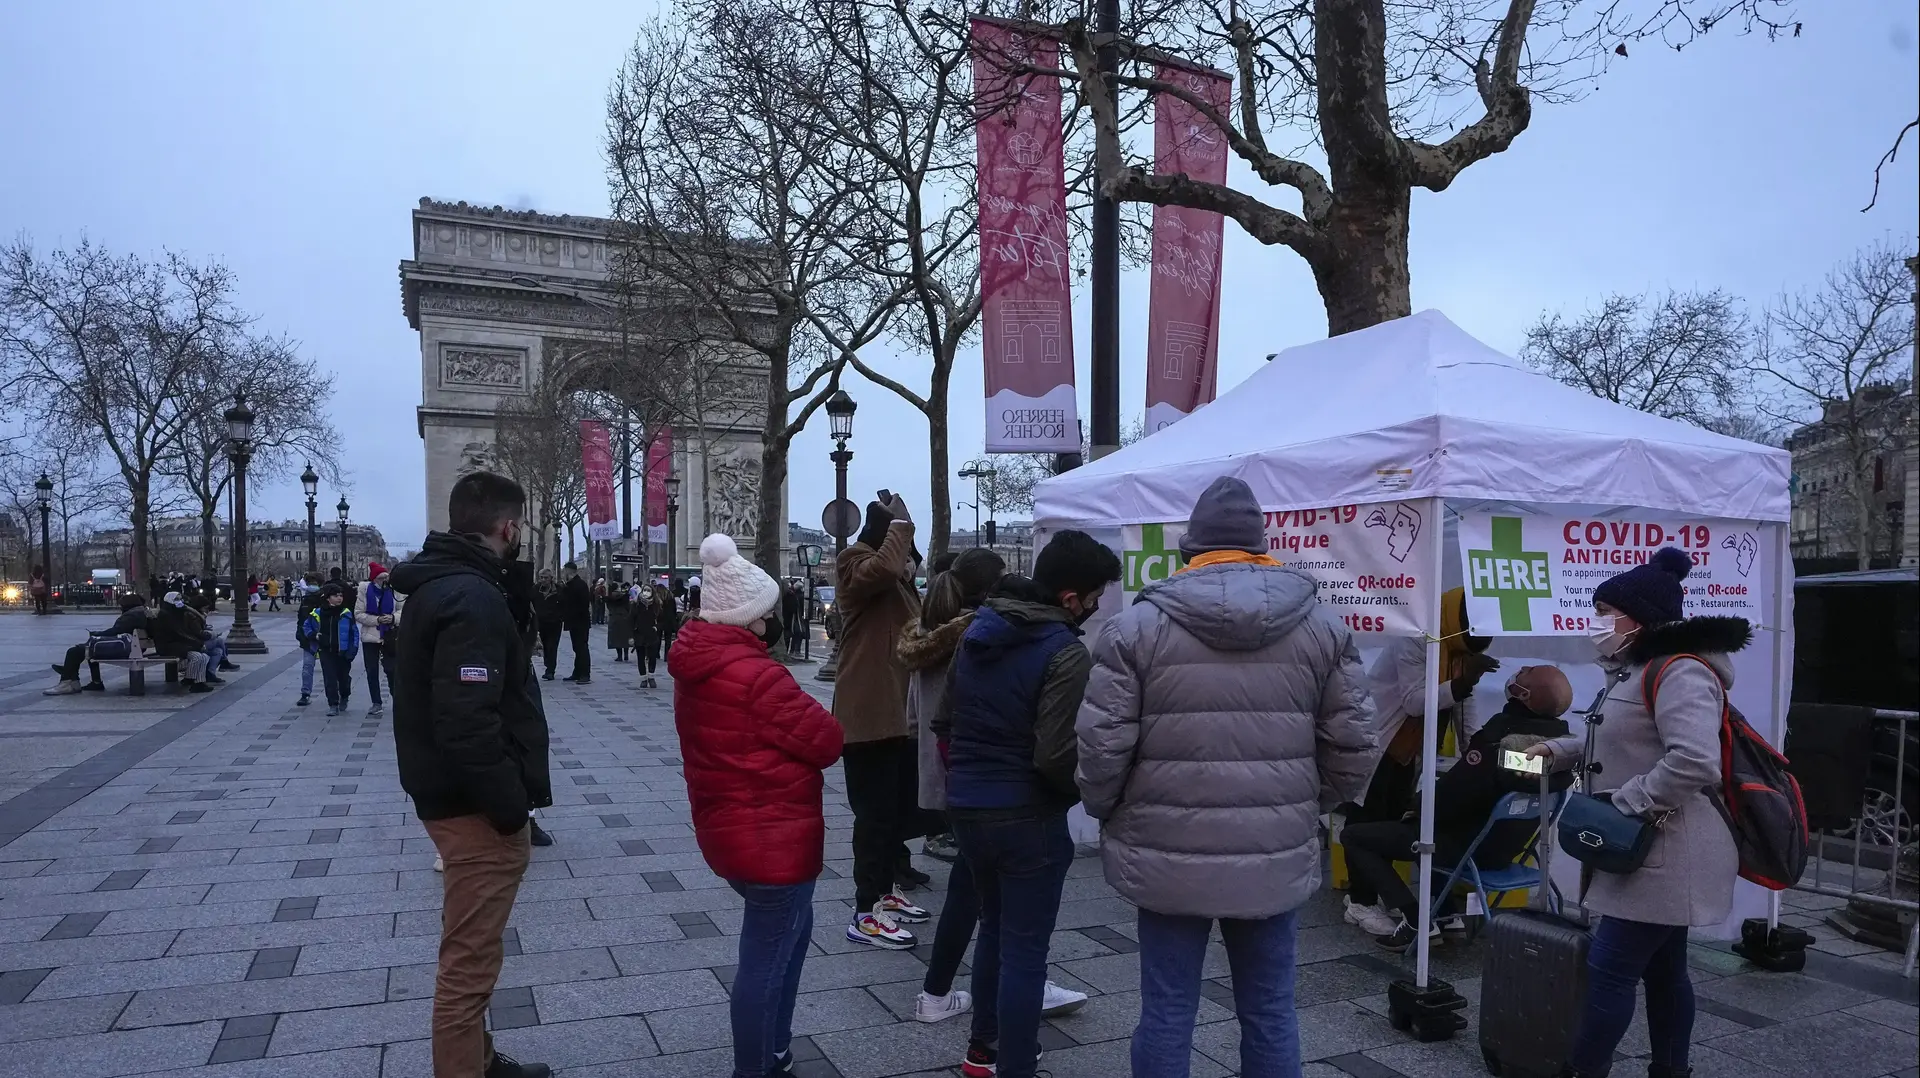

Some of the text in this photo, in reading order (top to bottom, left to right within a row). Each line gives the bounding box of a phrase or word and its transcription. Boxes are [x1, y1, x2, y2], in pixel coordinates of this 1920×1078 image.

[1264, 532, 1329, 553] nique
[1562, 520, 1711, 548] COVID-19
[1128, 554, 1177, 587] ICI
[1471, 556, 1549, 591] HERE
[1562, 569, 1573, 577] no
[1330, 580, 1354, 589] avec
[1357, 573, 1416, 592] QR-code
[1564, 585, 1583, 595] Your
[1690, 586, 1706, 595] with
[1707, 584, 1748, 597] QR-code
[1560, 598, 1572, 608] for
[1574, 599, 1592, 608] Mus
